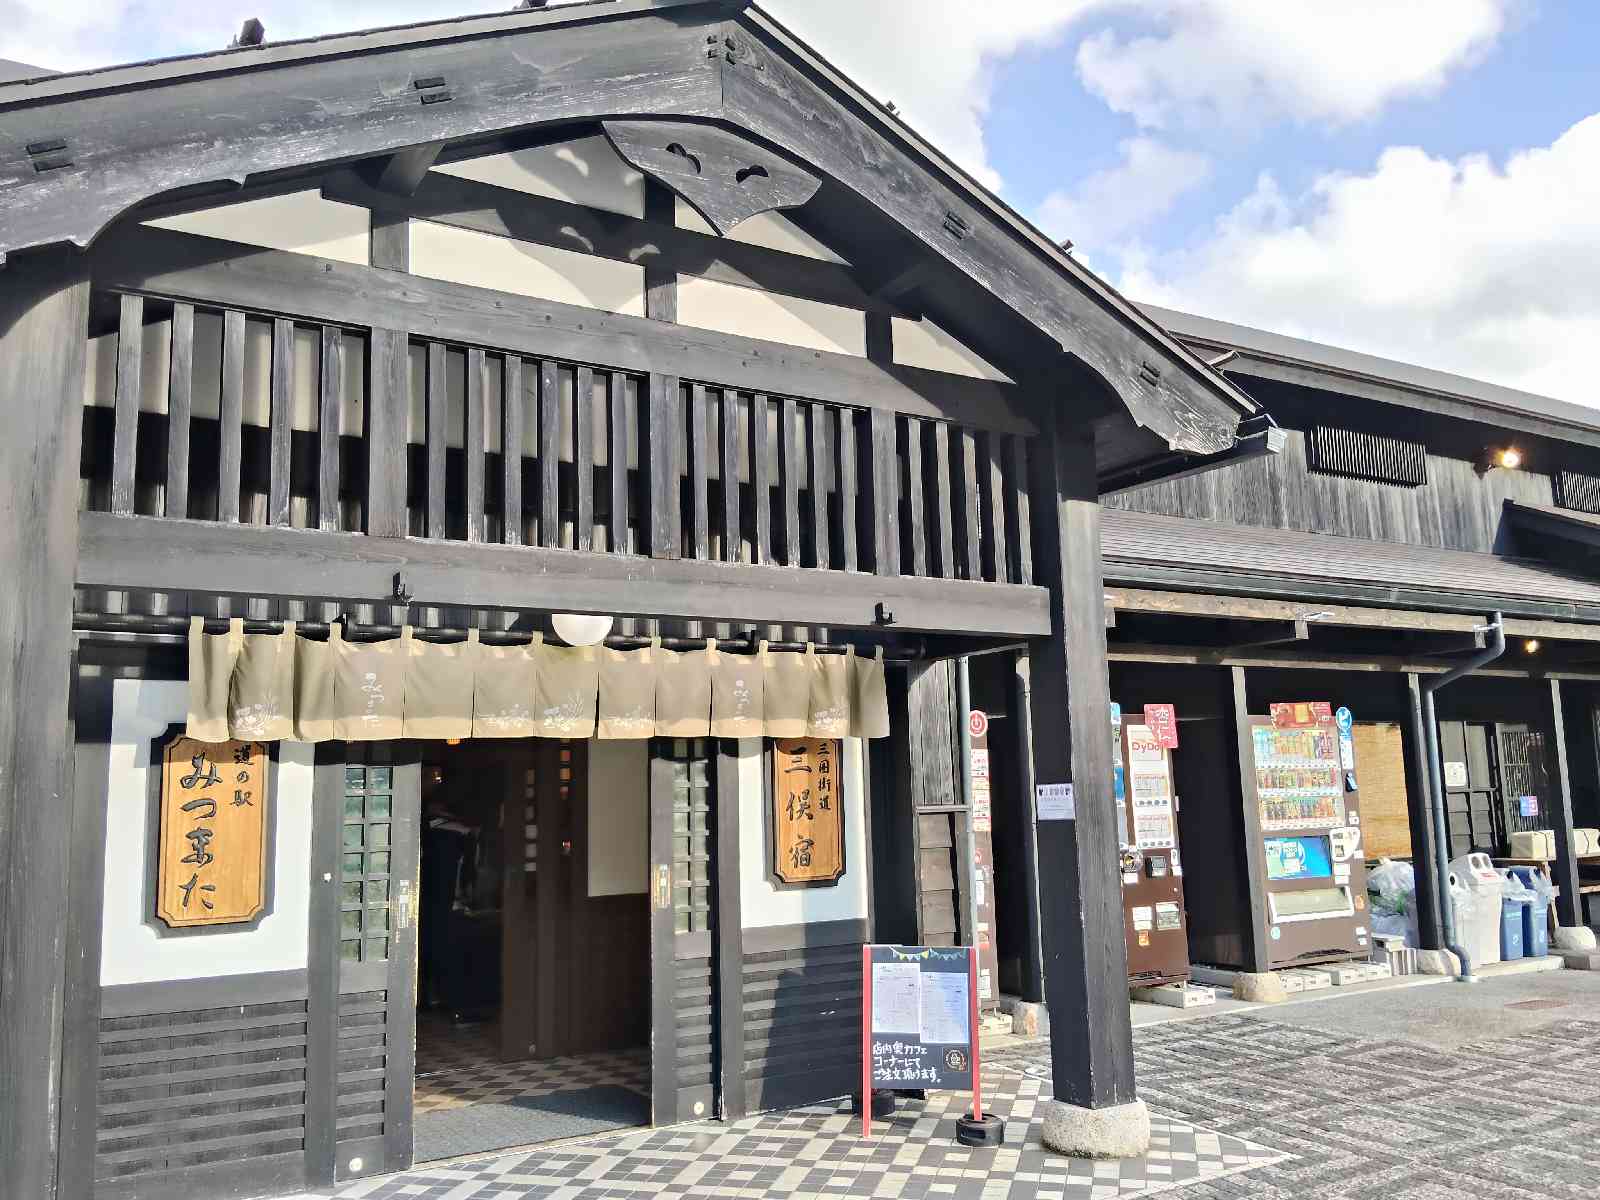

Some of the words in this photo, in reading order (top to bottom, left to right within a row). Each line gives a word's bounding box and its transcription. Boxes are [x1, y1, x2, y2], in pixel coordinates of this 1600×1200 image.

[229, 744, 255, 807] 道の駅
[1132, 741, 1160, 753] DyDo
[178, 750, 223, 910] みつまた
[784, 745, 815, 868] 三俣宿
[873, 1055, 921, 1068] コーナーにて
